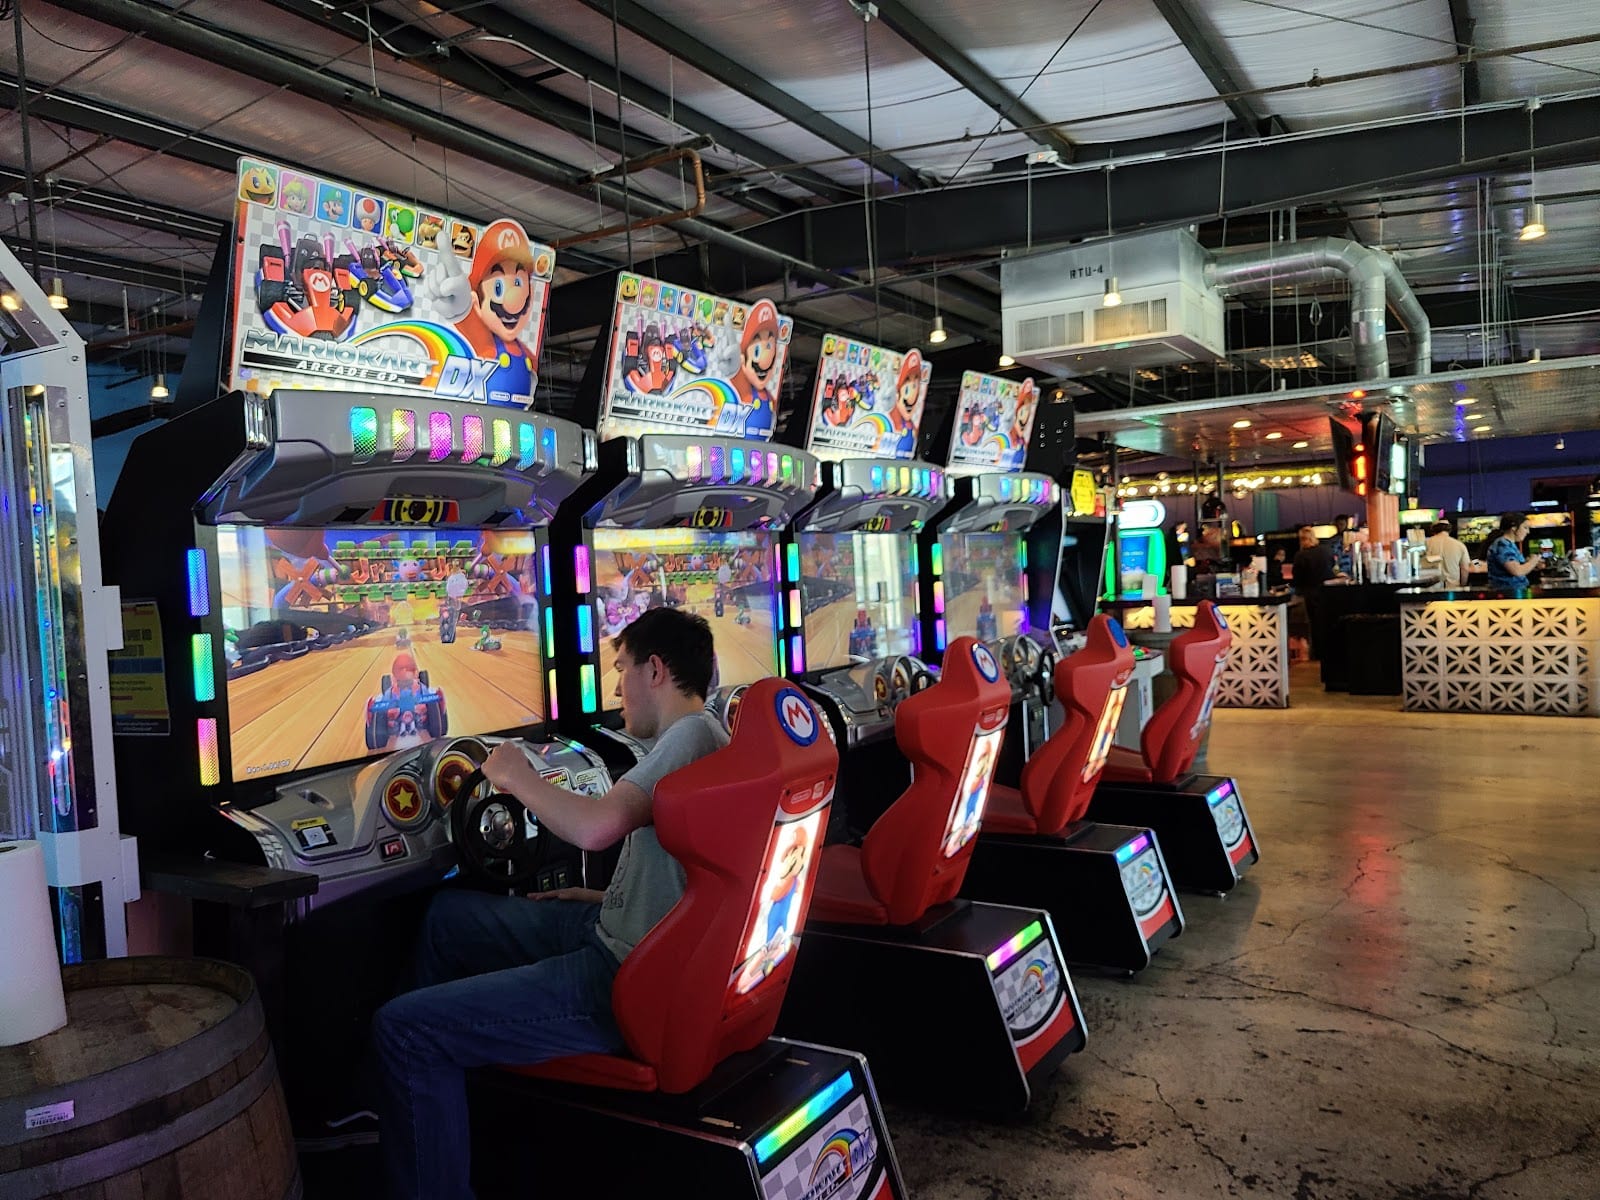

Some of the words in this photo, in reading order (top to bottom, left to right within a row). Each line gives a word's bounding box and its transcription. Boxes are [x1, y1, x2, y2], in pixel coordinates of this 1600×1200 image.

[1069, 264, 1103, 279] RTU-4
[296, 360, 368, 378] ARCADE
[376, 371, 399, 383] GP
[435, 354, 499, 401] DX
[717, 402, 753, 435] DX
[352, 558, 392, 584] Jr.
